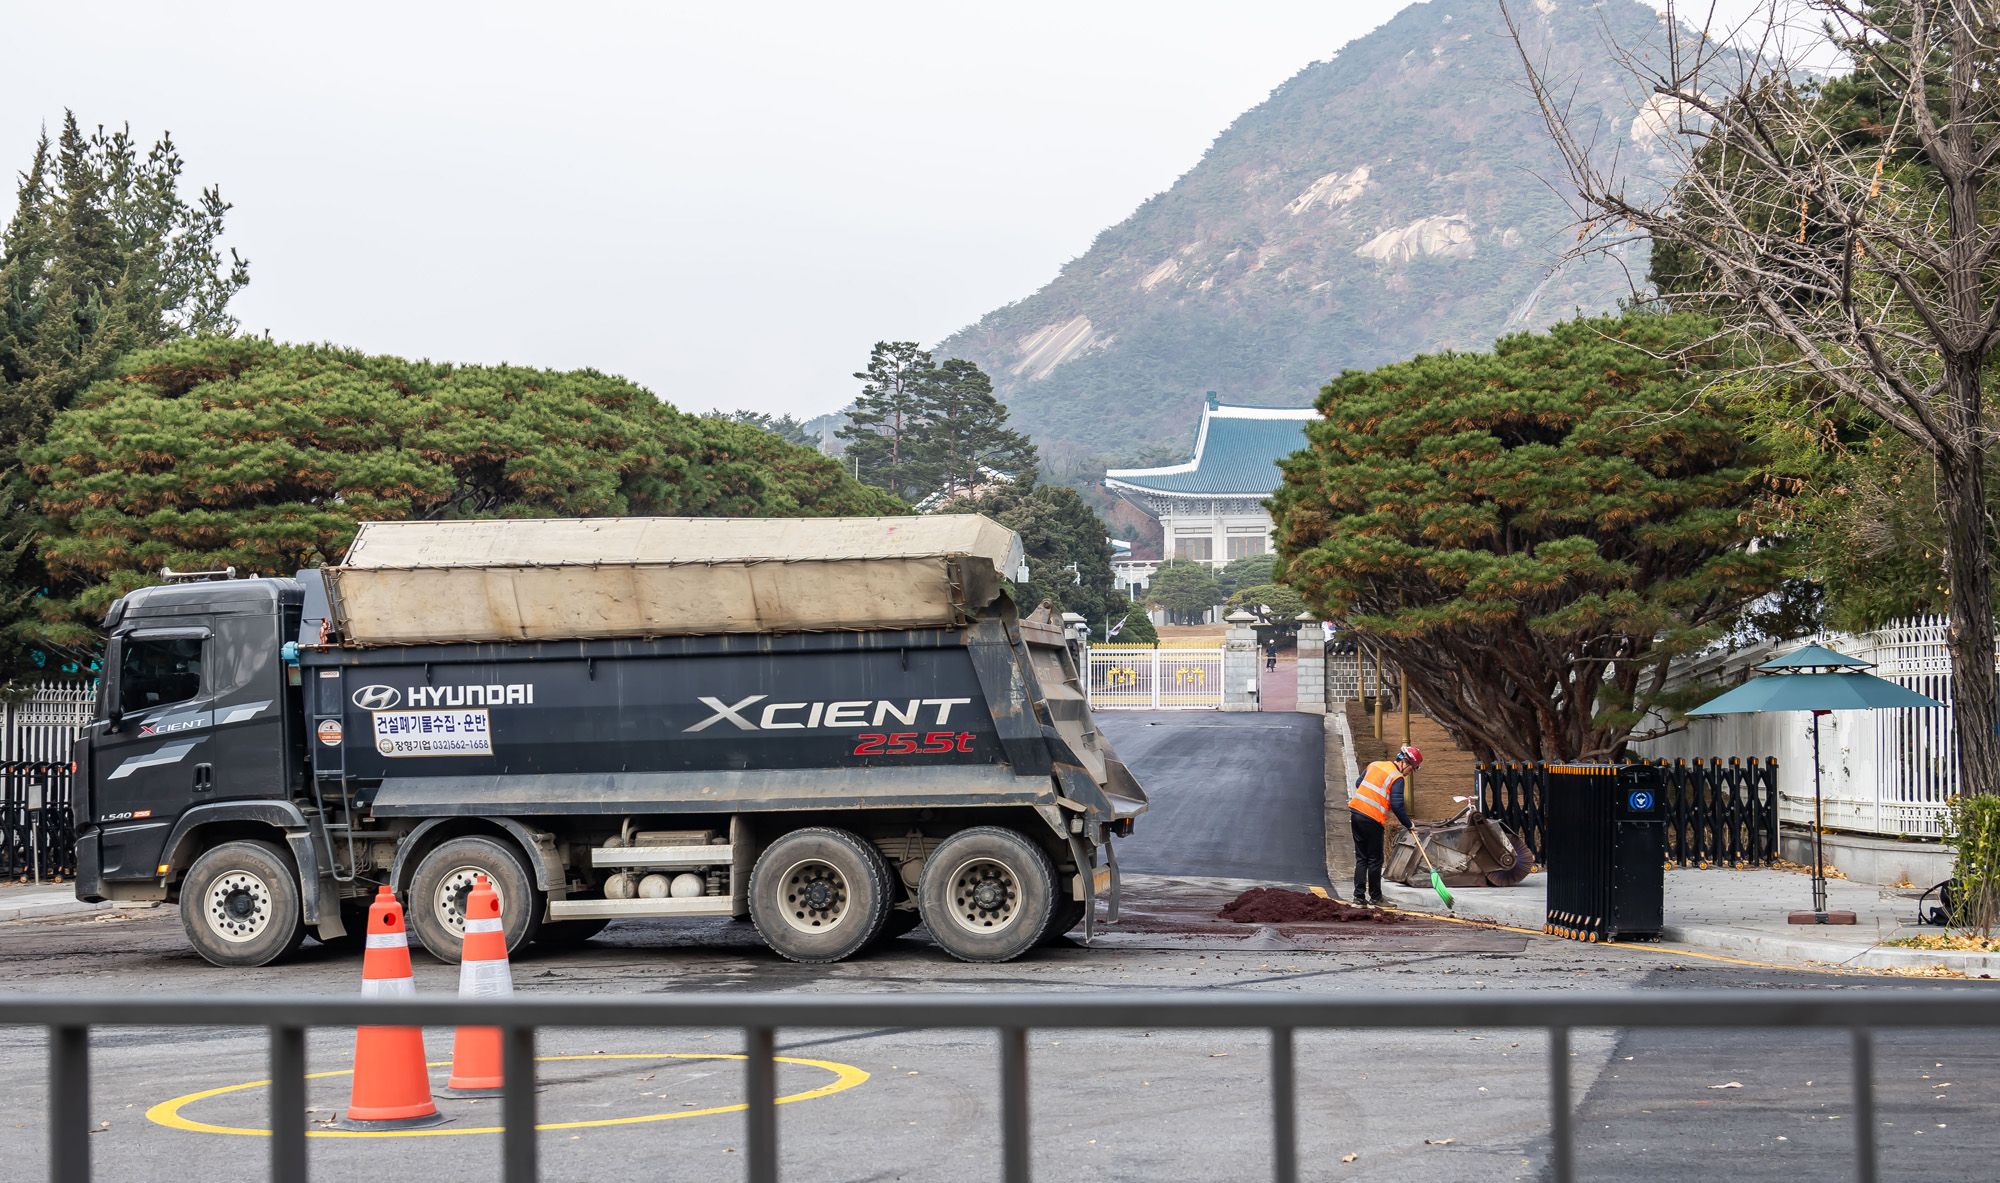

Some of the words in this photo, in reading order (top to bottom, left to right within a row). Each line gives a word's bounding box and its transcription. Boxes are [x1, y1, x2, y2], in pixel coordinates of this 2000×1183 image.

[408, 684, 533, 707] HYUNDAI
[680, 694, 972, 733] XCIENT
[137, 718, 206, 738] XCIENT
[433, 739, 490, 751] 032)562-1658
[853, 731, 977, 756] 25.5t
[101, 811, 132, 822] L540
